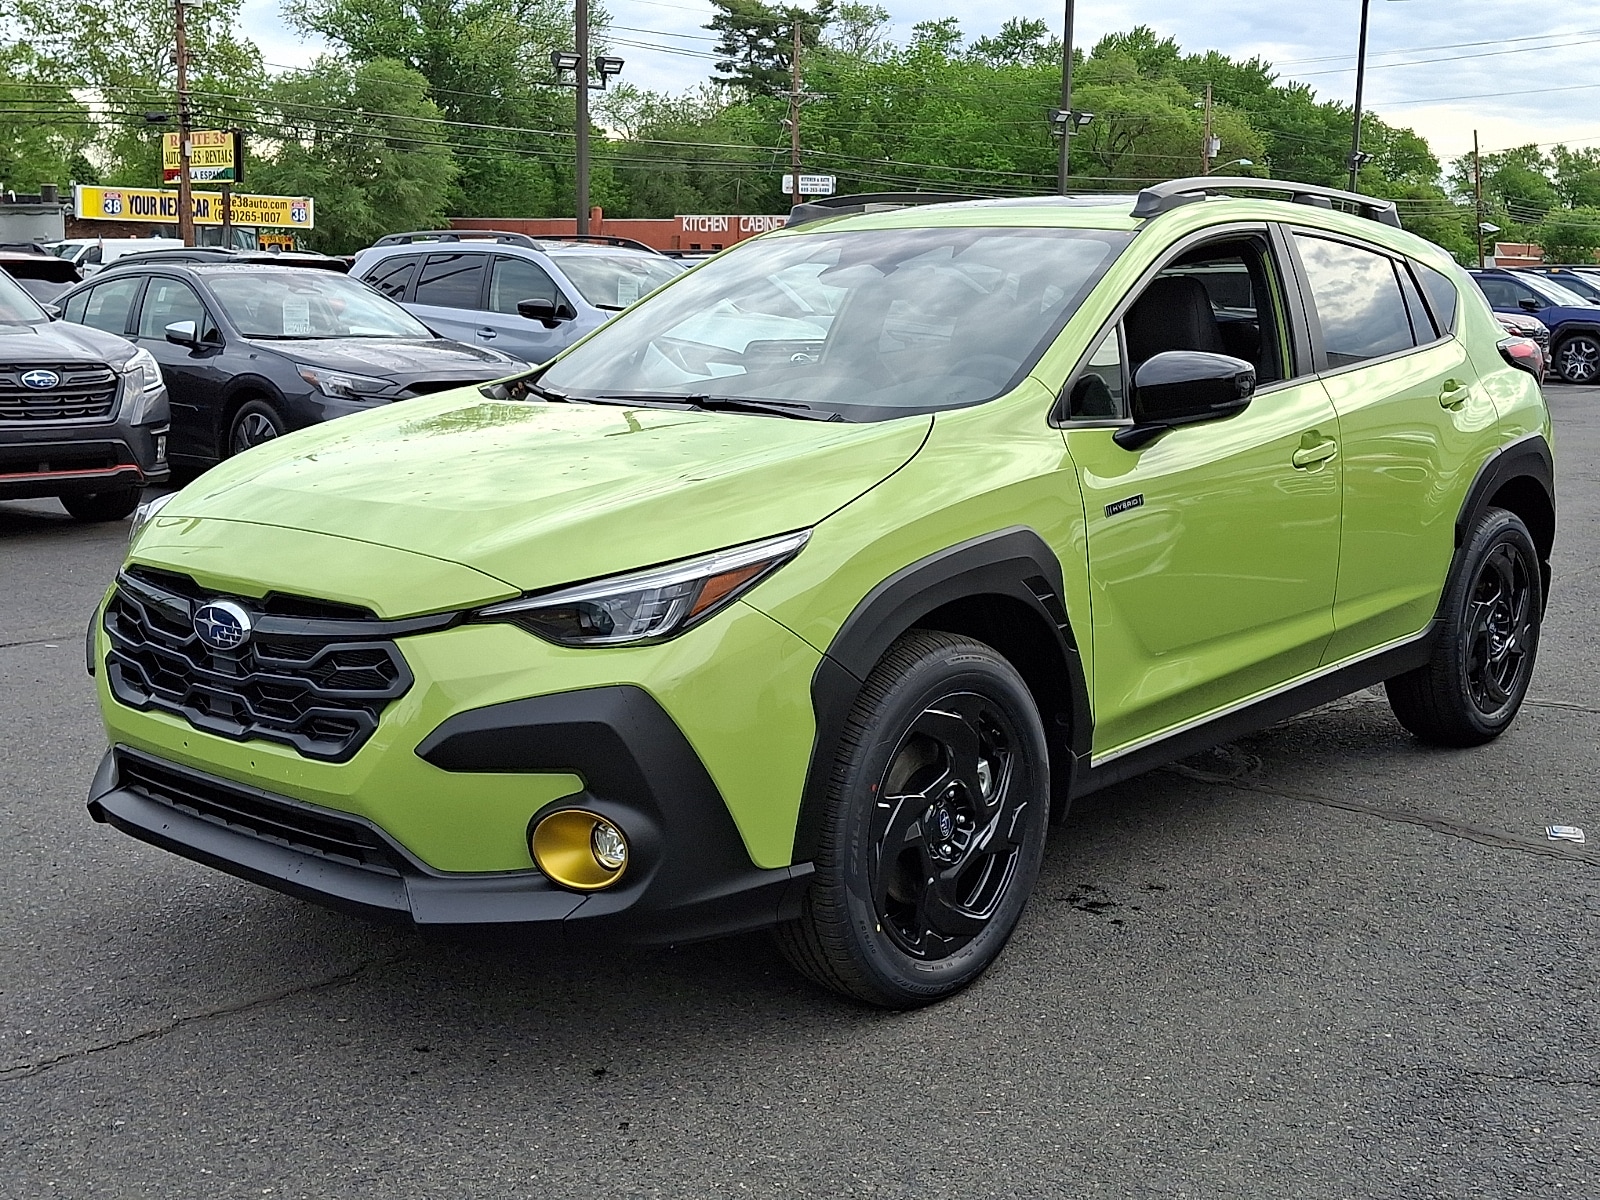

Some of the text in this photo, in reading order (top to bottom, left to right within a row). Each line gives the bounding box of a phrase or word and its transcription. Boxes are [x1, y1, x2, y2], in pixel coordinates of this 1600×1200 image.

[170, 132, 226, 146] RTE 38
[205, 149, 232, 163] RENTALS
[105, 199, 121, 213] 38
[127, 195, 157, 216] YOUR
[214, 197, 287, 210] roe38auto.com
[214, 209, 281, 223] (69)265-1007
[292, 208, 306, 221] 38
[682, 217, 729, 232] KITCHEN
[1112, 498, 1139, 512] HYBRID
